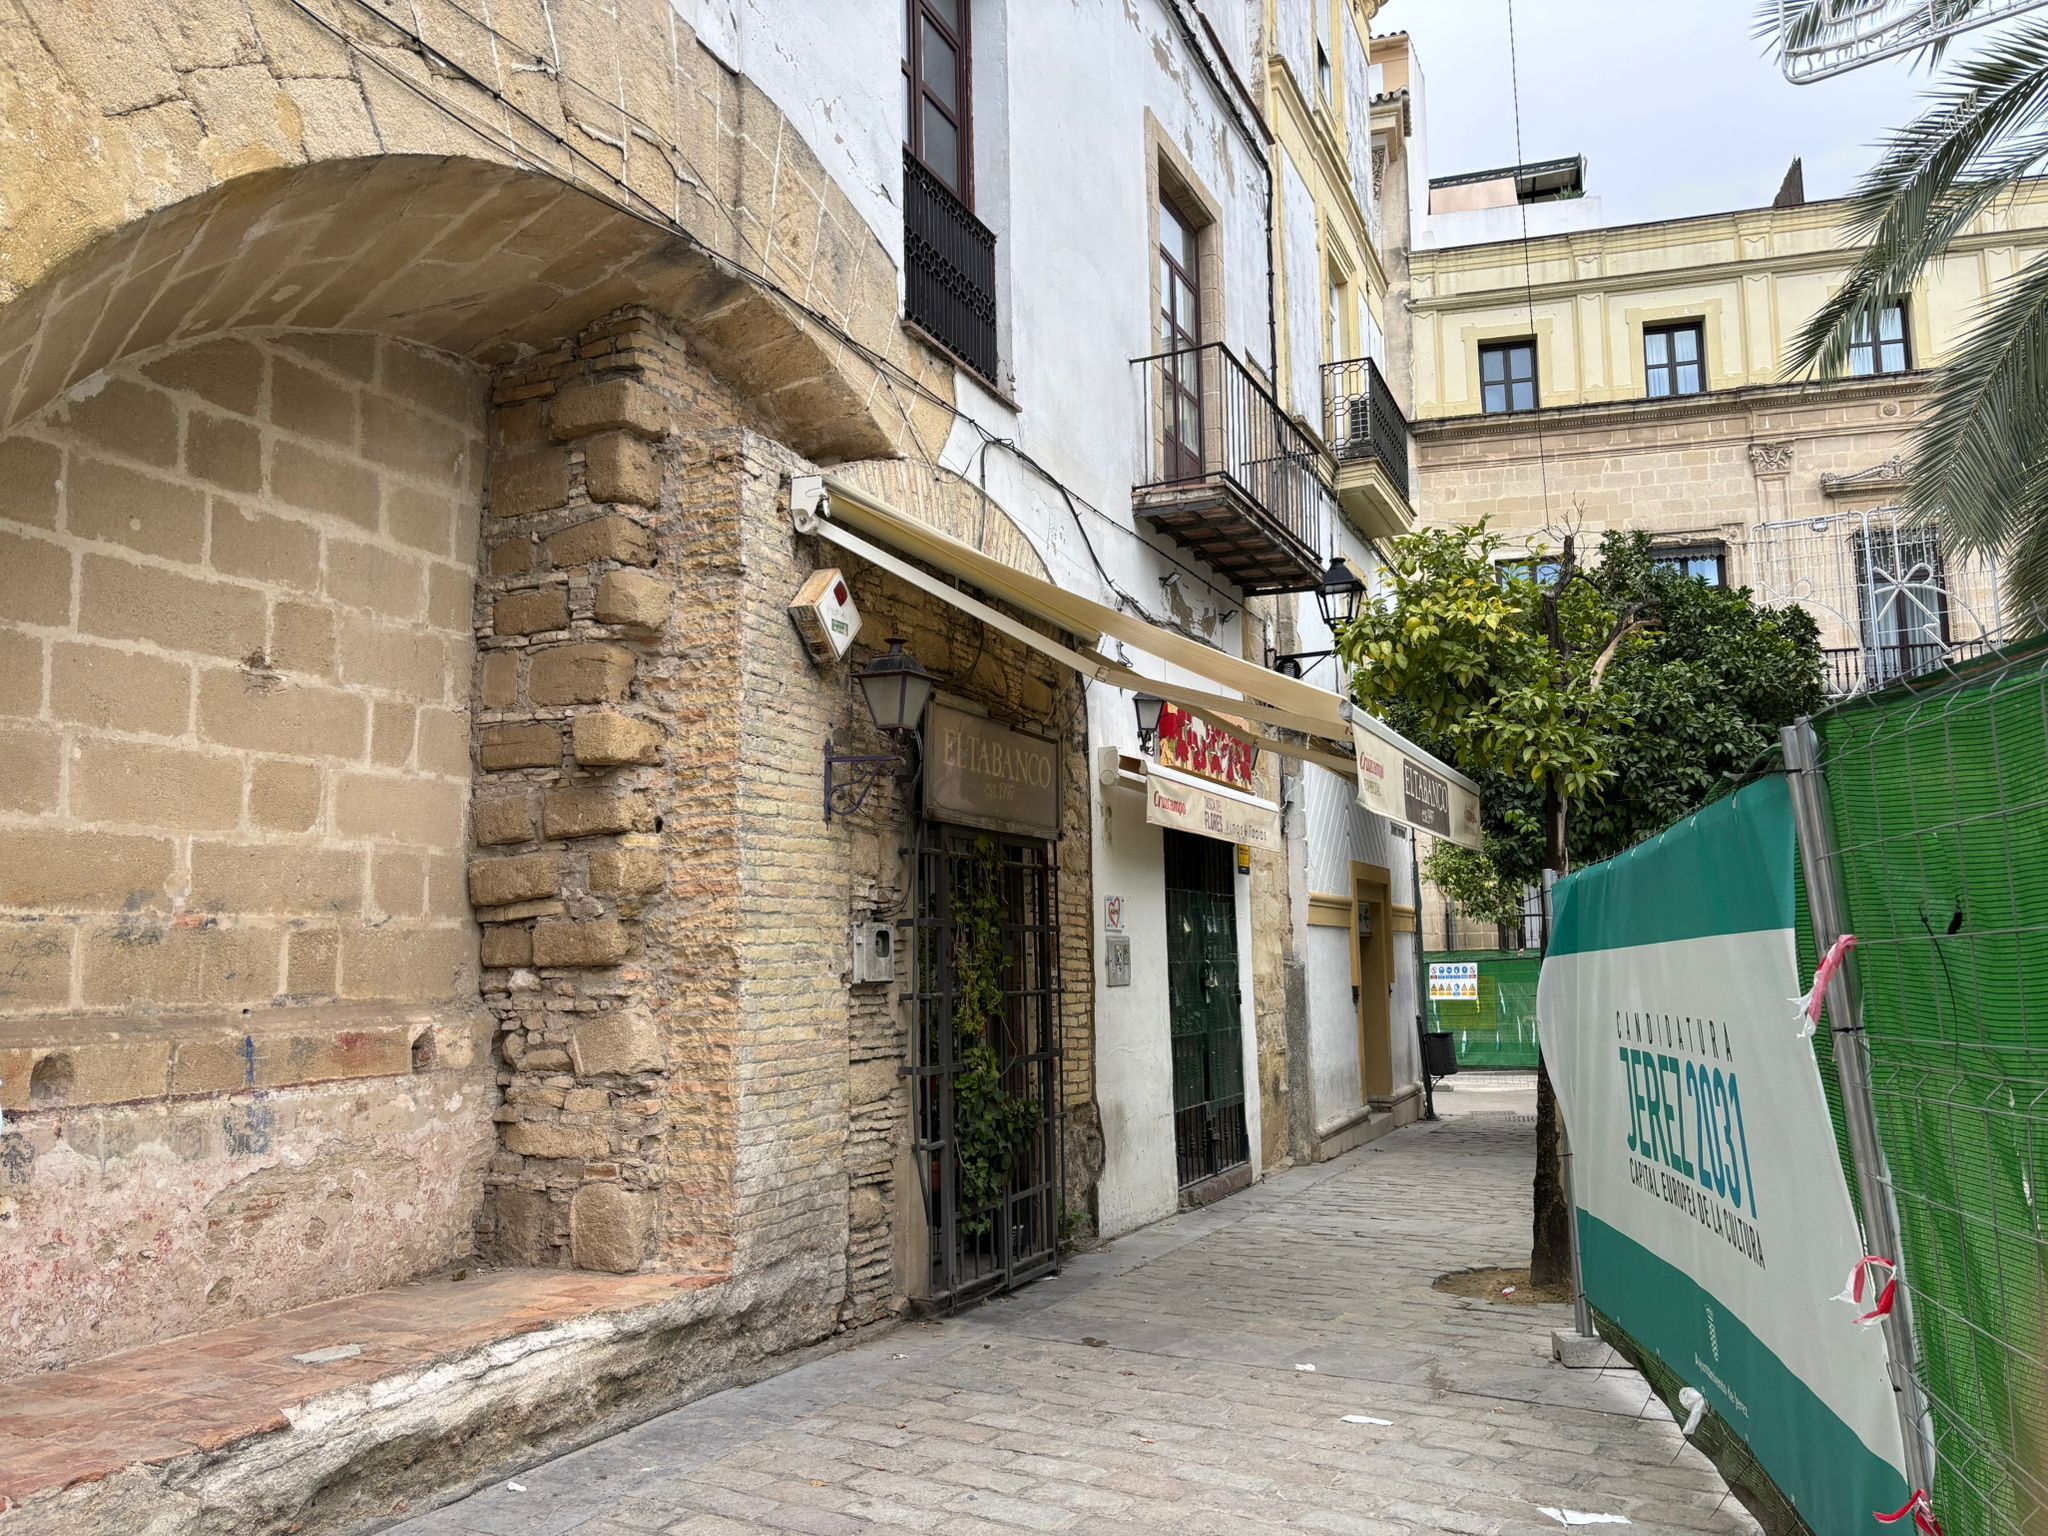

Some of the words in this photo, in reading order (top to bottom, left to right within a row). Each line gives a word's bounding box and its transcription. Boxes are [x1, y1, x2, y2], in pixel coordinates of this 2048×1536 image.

[967, 735, 1051, 788] TABANCO
[1154, 790, 1186, 816] Cruzcampo
[1413, 769, 1448, 813] TABANCO
[1204, 811, 1223, 833] FLORES
[1616, 1010, 1733, 1063] CANDIDATURA
[1619, 1046, 1695, 1181] JEREZ
[1686, 1060, 1757, 1220] 2031
[1629, 1157, 1660, 1198] CAPITAL
[1660, 1171, 1698, 1220] EUROPEA
[1697, 1191, 1711, 1229] DE
[1710, 1199, 1724, 1239] LA
[1723, 1208, 1766, 1271] CULTURA
